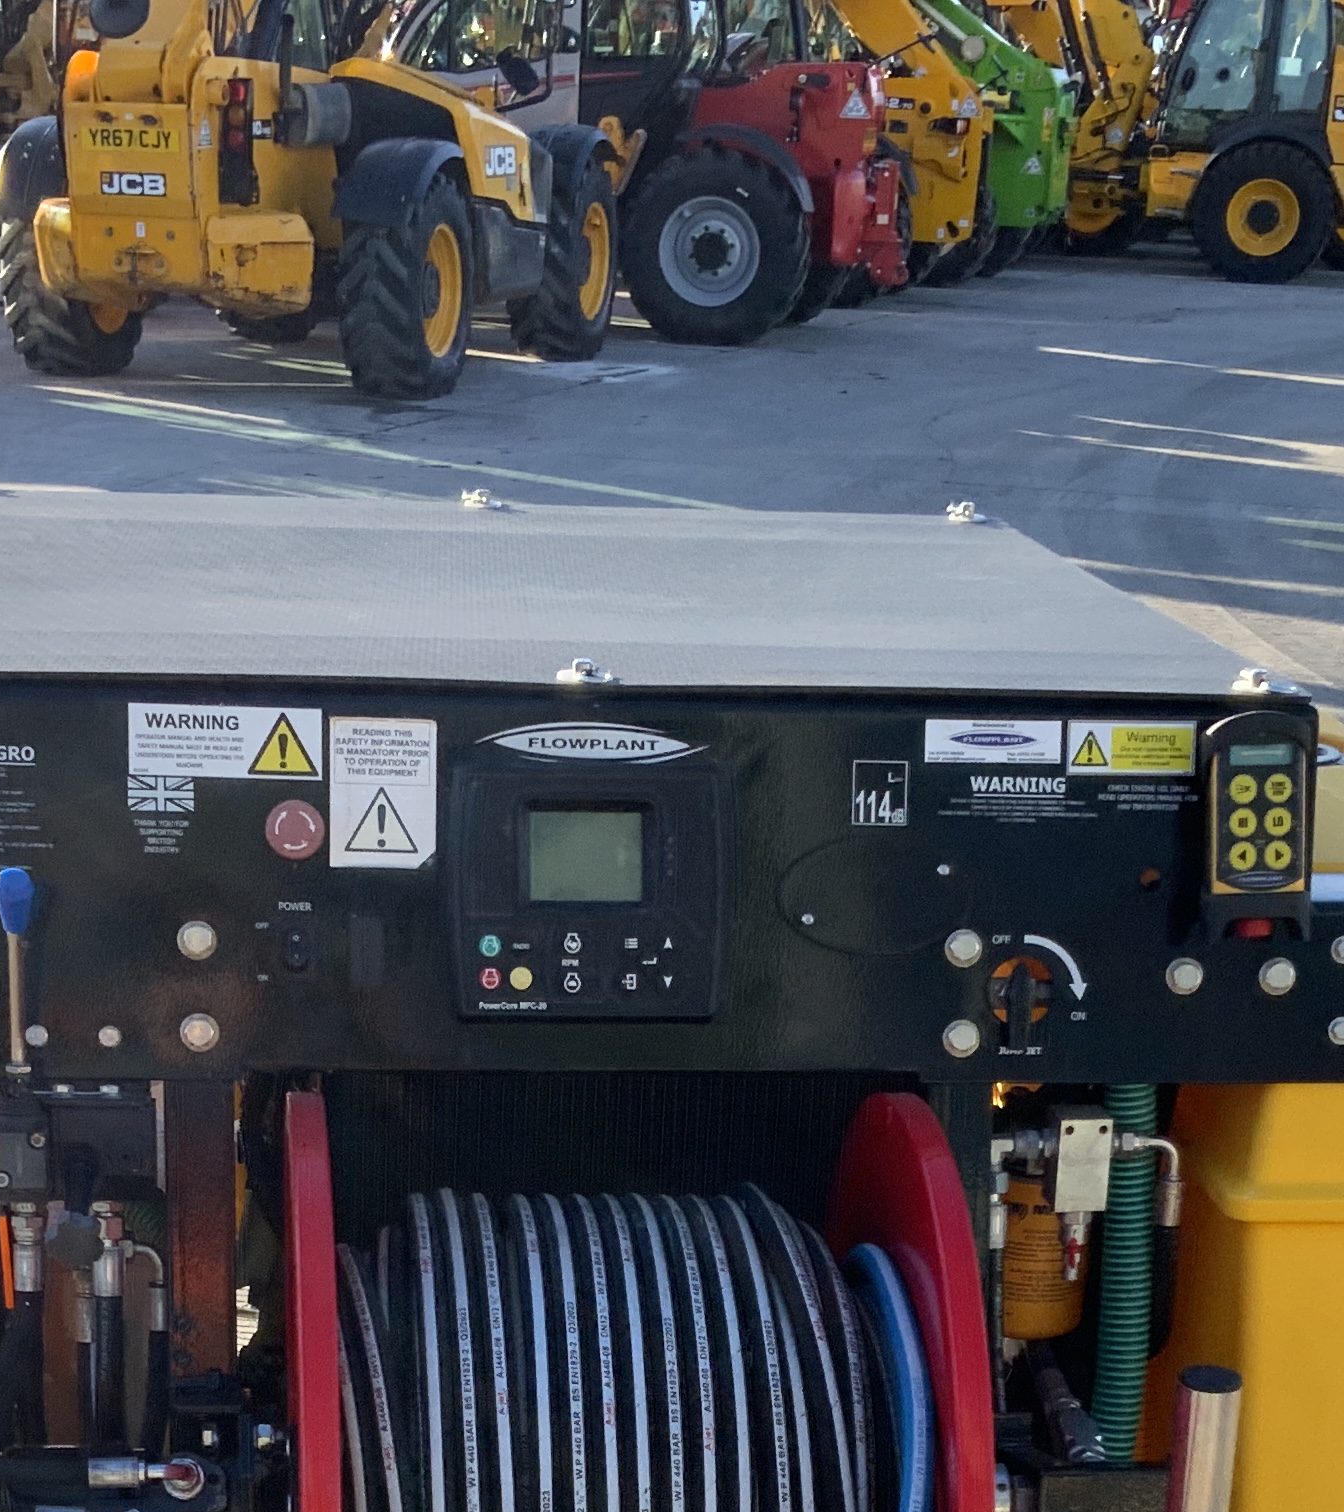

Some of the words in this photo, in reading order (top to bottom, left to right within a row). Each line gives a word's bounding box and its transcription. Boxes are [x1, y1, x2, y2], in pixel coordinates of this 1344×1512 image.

[89, 129, 133, 147] YR67
[139, 129, 171, 148] CJY
[486, 147, 516, 176] JCB
[102, 173, 166, 196] JCB
[145, 712, 239, 730] WARNING
[352, 728, 391, 737] READING
[1126, 731, 1177, 746] Warning
[335, 738, 368, 746] SAFETY
[371, 739, 429, 748] INFORMATION
[528, 737, 659, 750] FLOWPLANT
[347, 748, 401, 756] MANDATORY
[358, 758, 407, 767] OPERATION
[347, 767, 366, 775] THIS
[368, 768, 418, 777] EQUIPMENT
[970, 776, 1066, 793] WARNING
[855, 790, 891, 823] 114
[891, 808, 904, 823] dB
[278, 901, 312, 911] POWER
[992, 935, 1011, 945] OFF
[561, 959, 579, 967] RPM
[1070, 1011, 1088, 1021] ON
[698, 1335, 707, 1360] DN12
[464, 1395, 473, 1410] BS
[571, 1388, 581, 1402] BS
[572, 1410, 582, 1434] BAR
[670, 1407, 679, 1423] BS
[465, 1419, 475, 1443] BAR
[574, 1437, 582, 1456] 440
[671, 1432, 681, 1456] BAR
[466, 1445, 476, 1464] 440
[672, 1459, 682, 1478] 440
